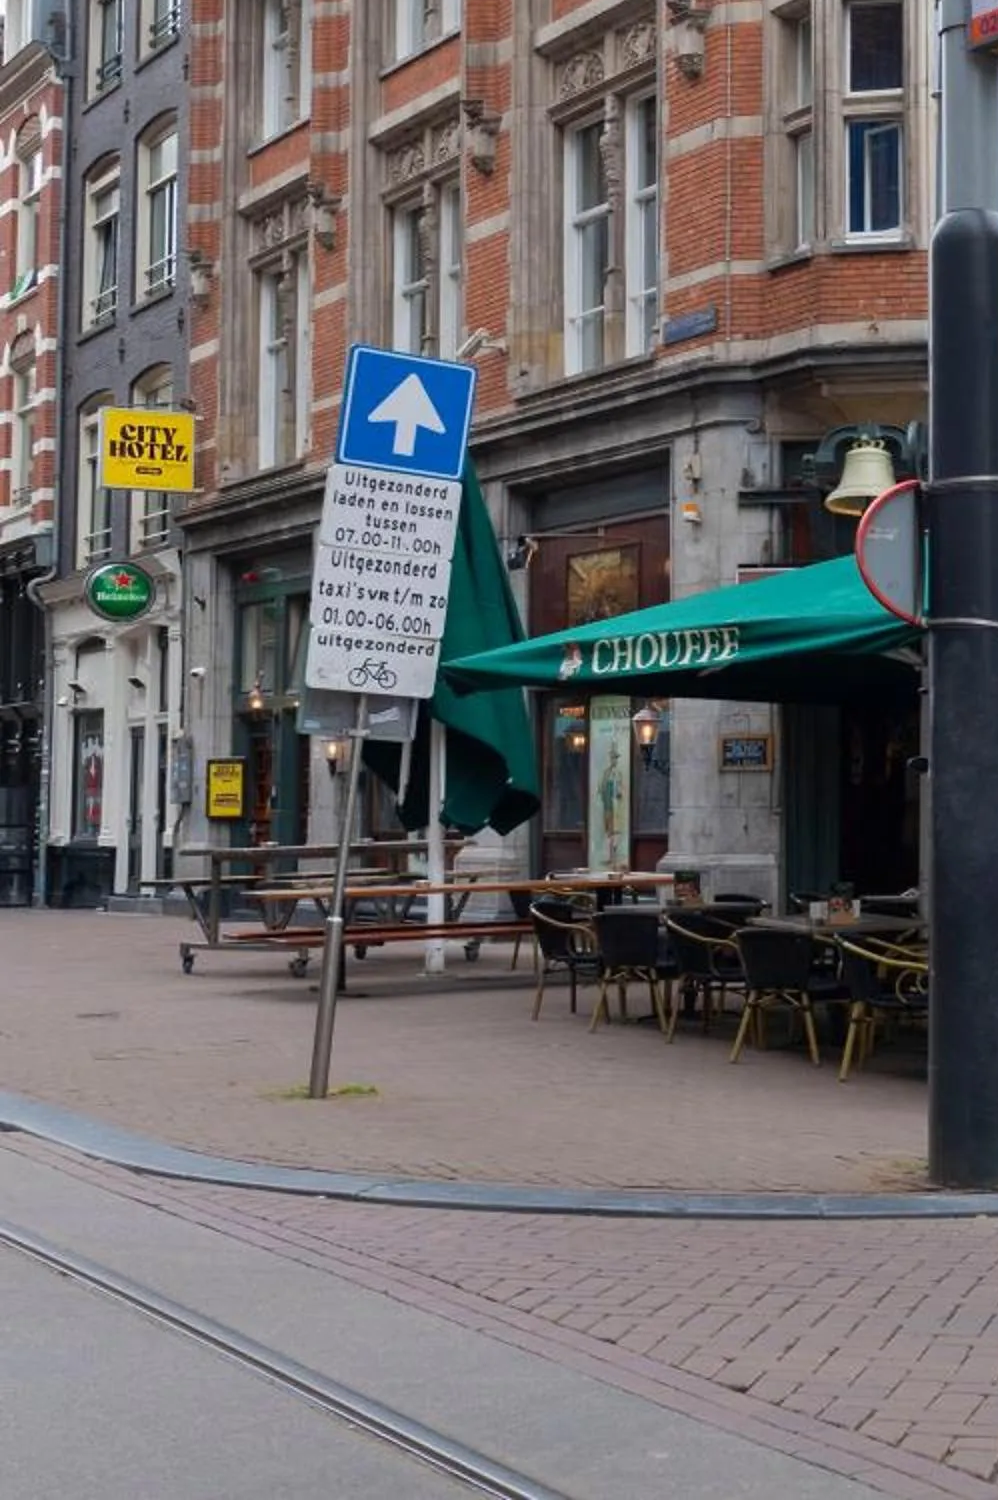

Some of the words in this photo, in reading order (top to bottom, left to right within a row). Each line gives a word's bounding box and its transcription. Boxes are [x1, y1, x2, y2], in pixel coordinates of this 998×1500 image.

[120, 424, 176, 446] CITY
[109, 440, 188, 462] HOTEL
[345, 471, 449, 500] Uitgezonderd
[333, 490, 375, 510] laden
[381, 500, 399, 513] en
[405, 501, 453, 521] lossen
[366, 513, 417, 533] tussen
[335, 527, 441, 555] 07.00-11.00h
[331, 550, 437, 579] Uitgezonderd
[393, 587, 423, 607] t/m
[429, 595, 446, 609] zo
[323, 606, 432, 635] 01.00-06.00h
[317, 633, 435, 657] uitgezonderd
[591, 627, 740, 675] CHOUFFE
